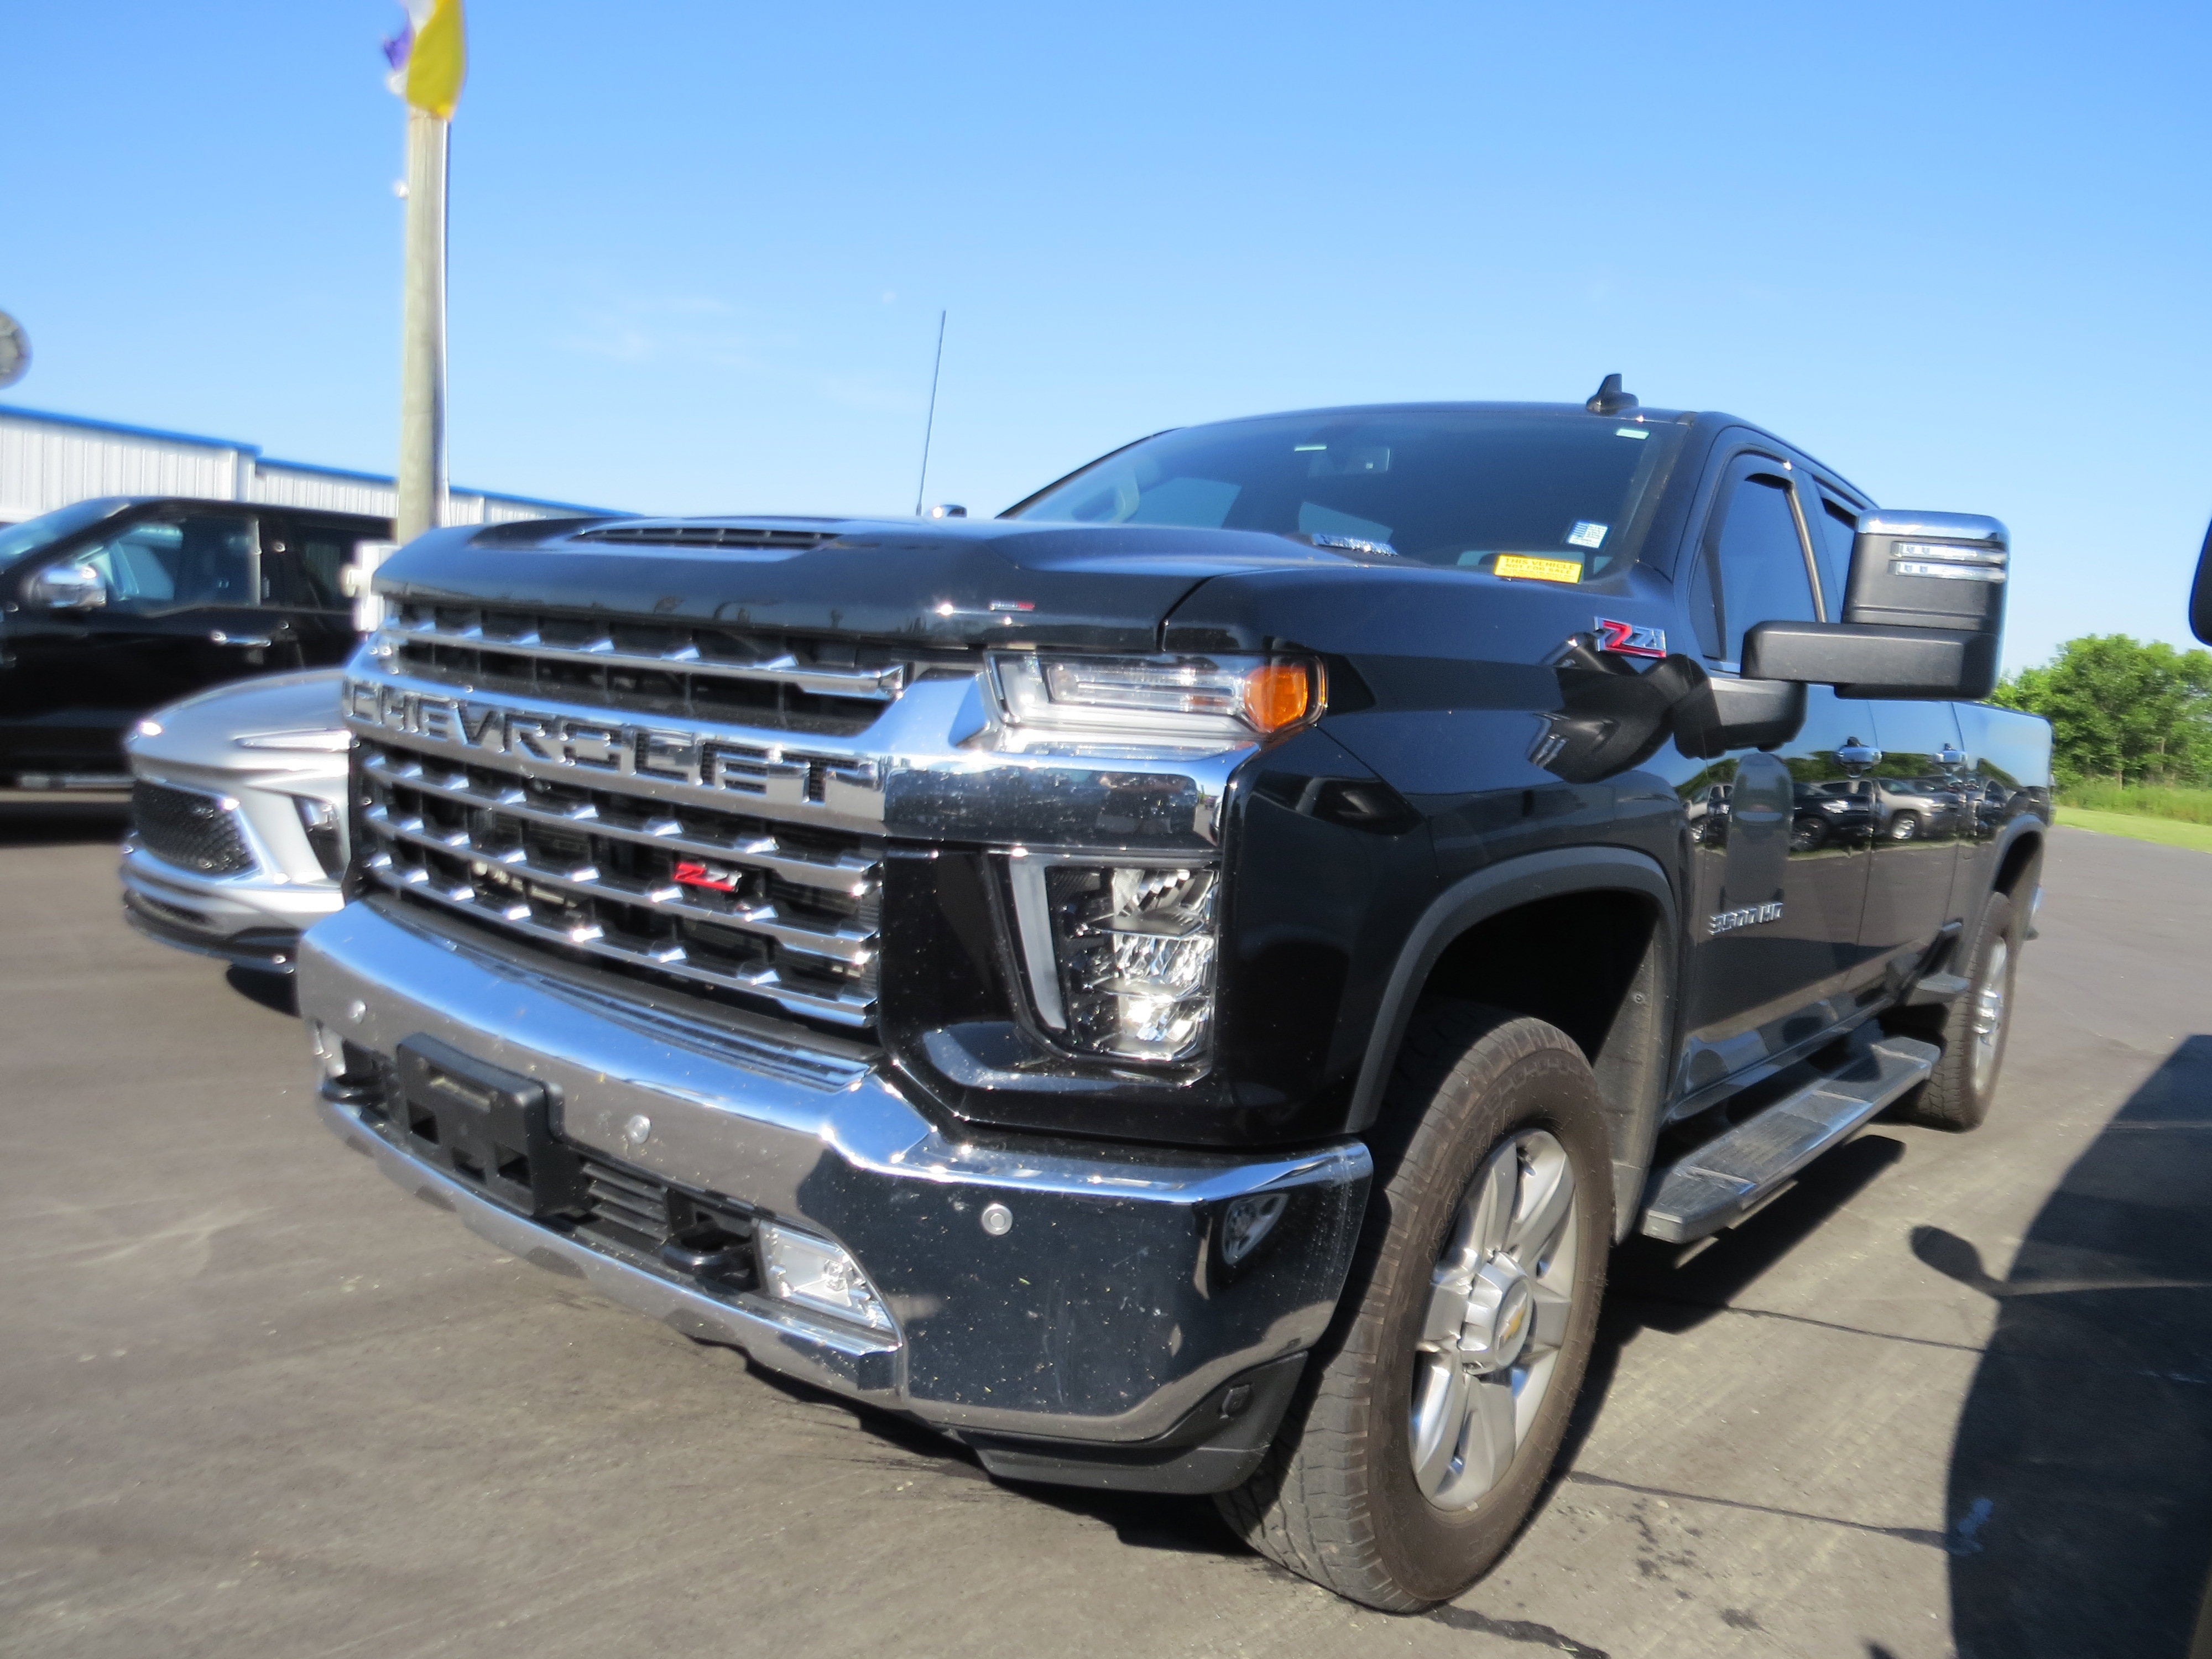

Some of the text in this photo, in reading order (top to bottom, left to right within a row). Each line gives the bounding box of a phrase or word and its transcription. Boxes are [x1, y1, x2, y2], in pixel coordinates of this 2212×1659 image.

[1532, 561, 1575, 570] VEHICLE
[1594, 615, 1667, 658] Z71
[346, 682, 861, 806] CHEVROLET
[674, 862, 743, 893] Z71
